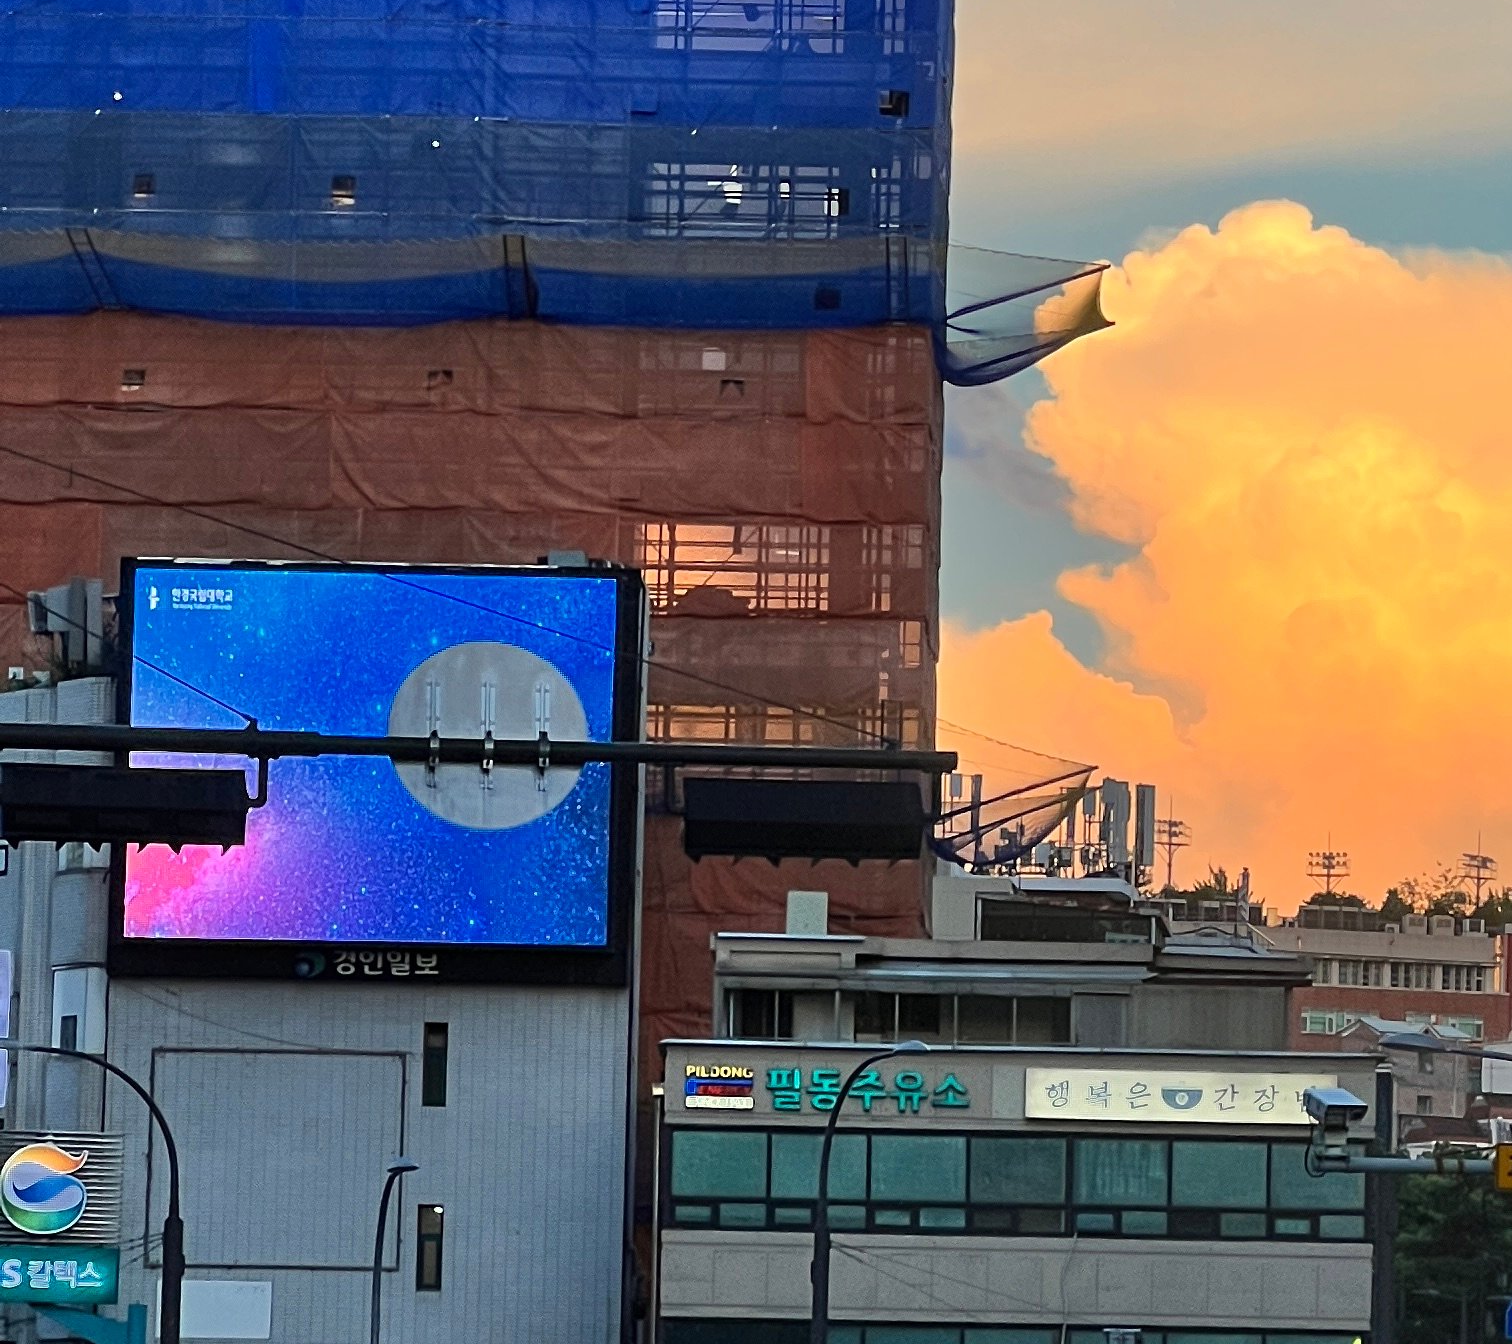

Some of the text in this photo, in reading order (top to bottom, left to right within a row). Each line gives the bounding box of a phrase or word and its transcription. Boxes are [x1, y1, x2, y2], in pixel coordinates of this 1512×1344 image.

[333, 951, 440, 976] 경인일보
[685, 1065, 754, 1079] PILDONG
[766, 1067, 970, 1112] 필동주유소
[27, 1260, 103, 1289] 칼텍스
